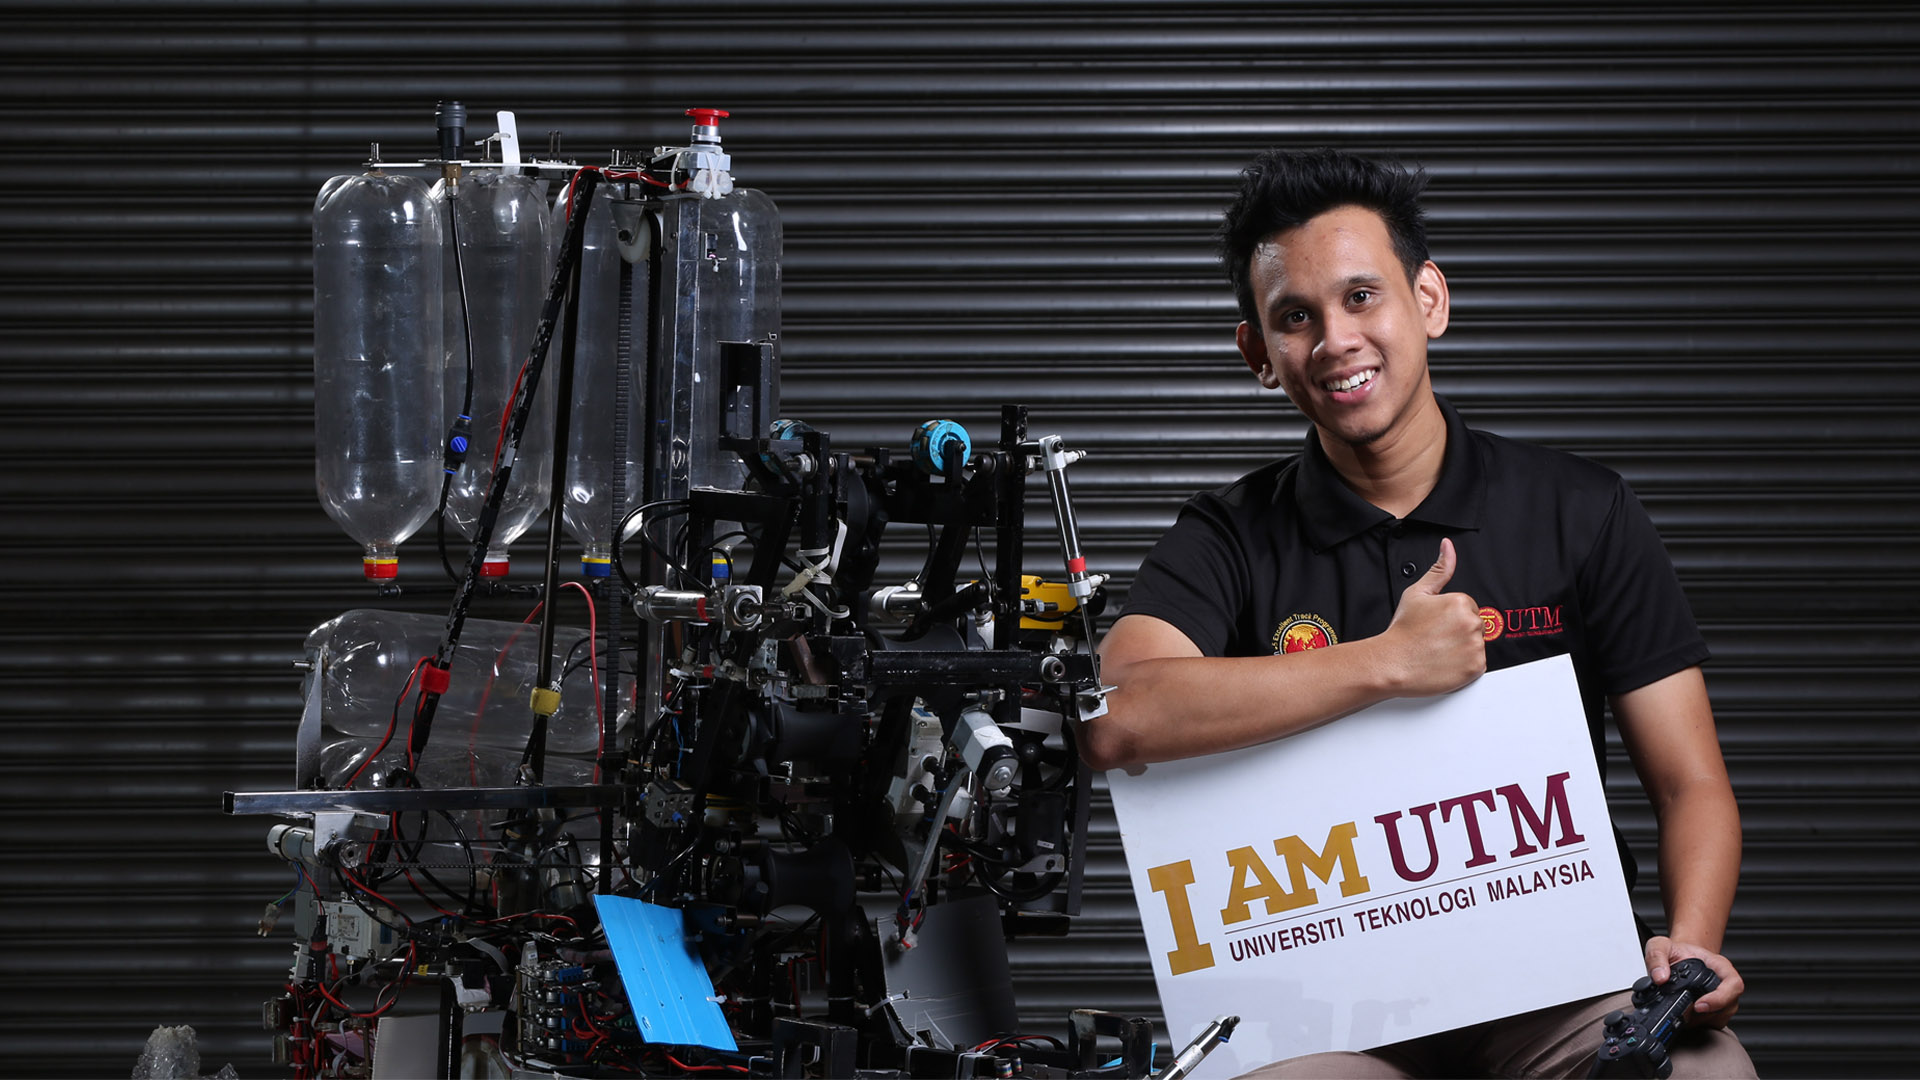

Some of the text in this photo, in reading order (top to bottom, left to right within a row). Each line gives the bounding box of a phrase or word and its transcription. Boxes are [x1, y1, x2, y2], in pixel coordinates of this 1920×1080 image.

[1504, 605, 1564, 632] UTM
[1148, 771, 1586, 976] I AM UTM
[1229, 860, 1595, 962] UNIVERSITI TEKNOLOGI MALAYSIA
